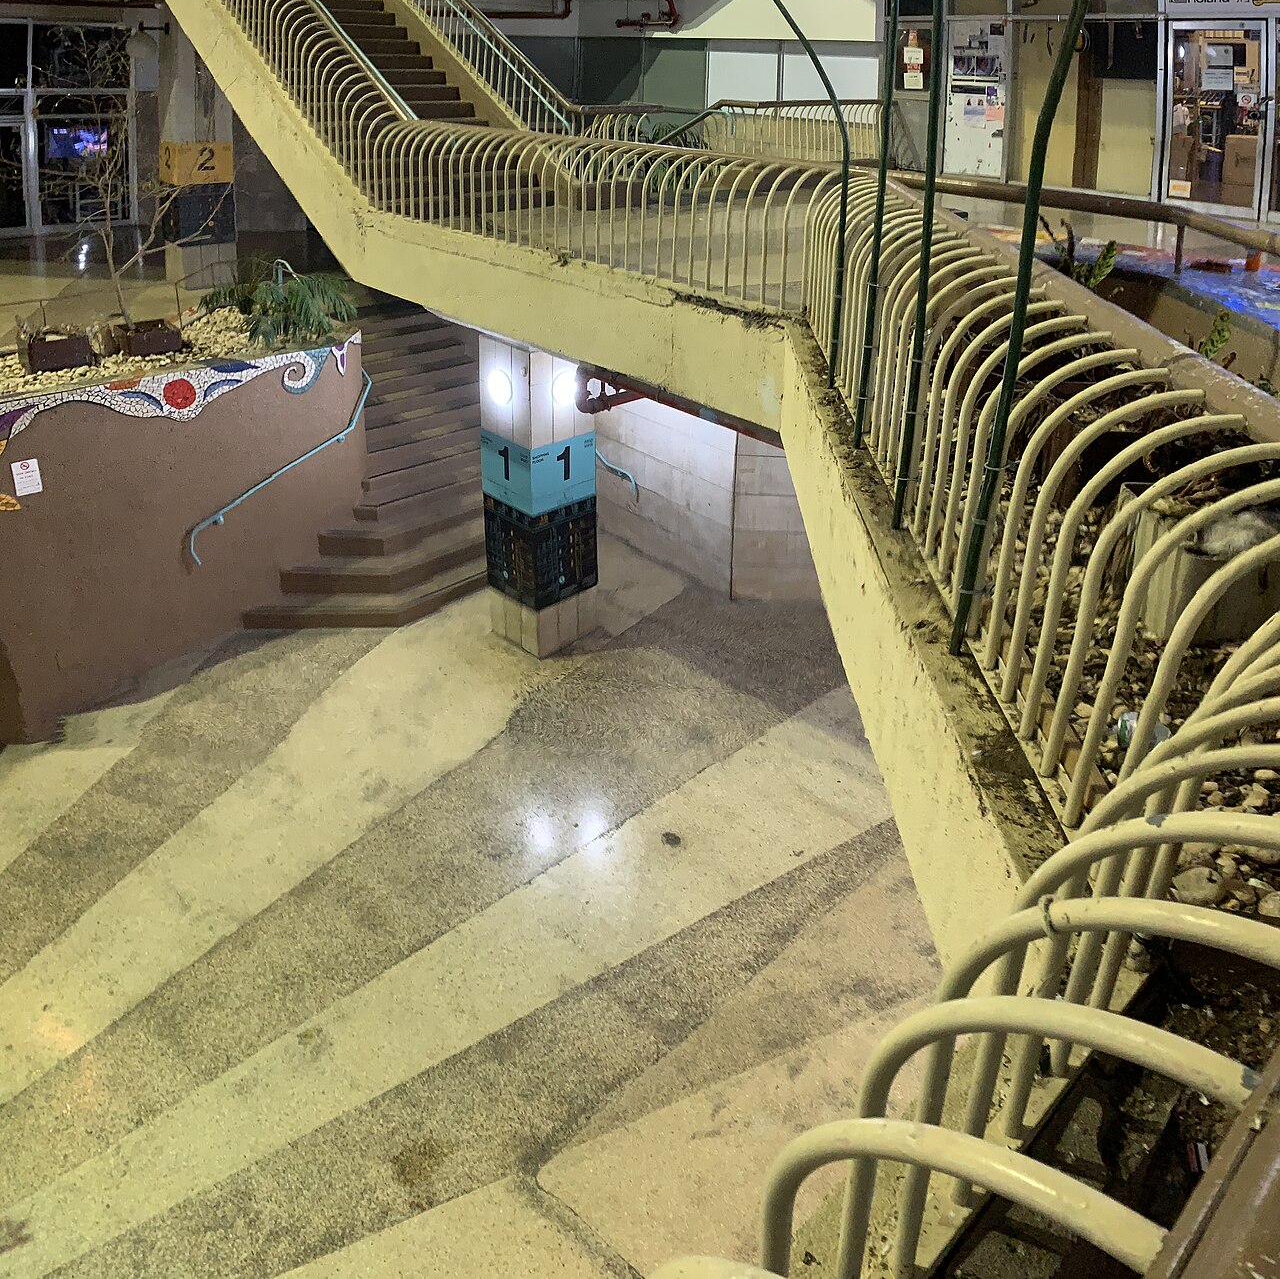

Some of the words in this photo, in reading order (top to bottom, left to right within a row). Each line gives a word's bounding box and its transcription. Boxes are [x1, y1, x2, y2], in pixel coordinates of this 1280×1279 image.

[165, 146, 171, 170] 2
[198, 146, 216, 171] 2
[498, 445, 510, 481] 1
[557, 445, 571, 481] 1
